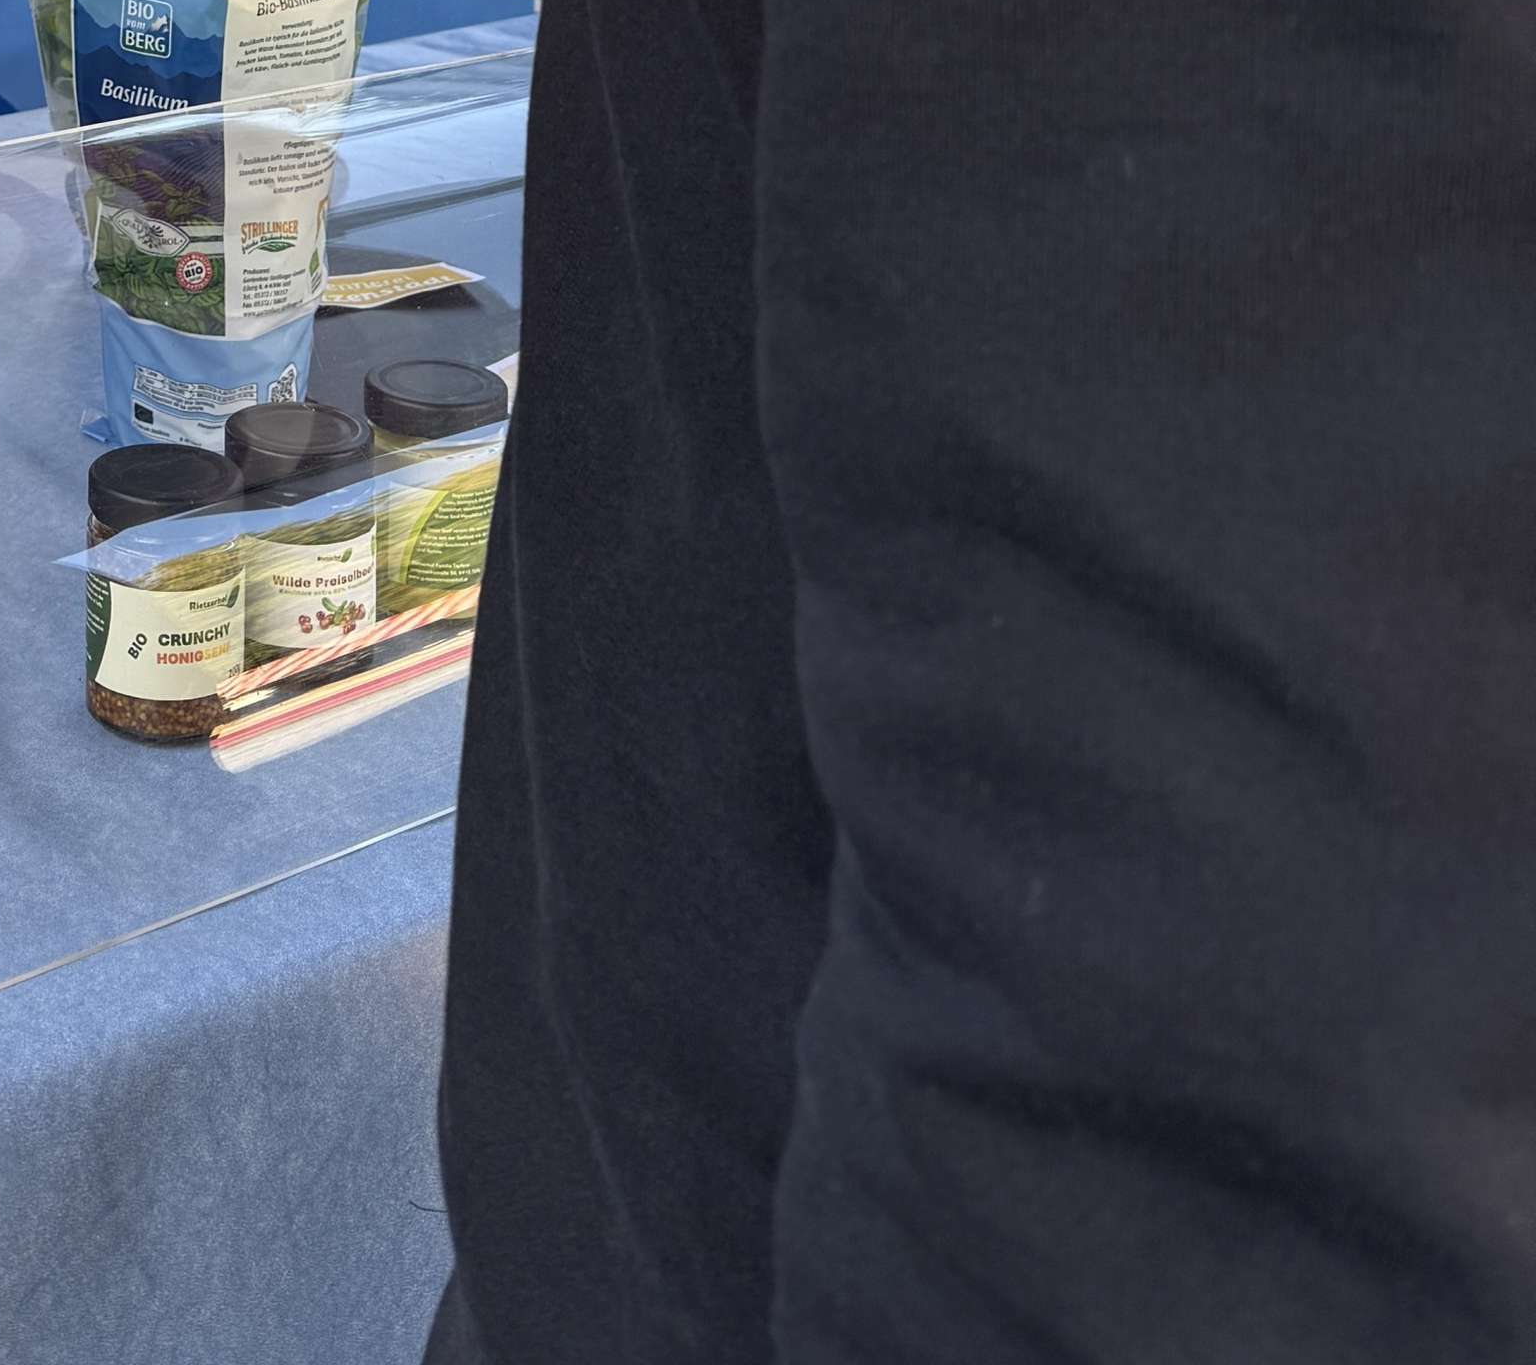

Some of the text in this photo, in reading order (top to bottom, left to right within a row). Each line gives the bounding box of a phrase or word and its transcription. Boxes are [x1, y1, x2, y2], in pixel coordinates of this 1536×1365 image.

[127, 0, 154, 20] BIO
[126, 19, 146, 30] vom
[125, 29, 166, 53] BERG
[101, 78, 189, 111] Basilikum
[240, 220, 298, 244] STRILLINGER
[184, 266, 203, 278] BIO
[272, 574, 312, 588] Wilde
[128, 632, 148, 660] BIO
[158, 622, 231, 646] CRUNCHY
